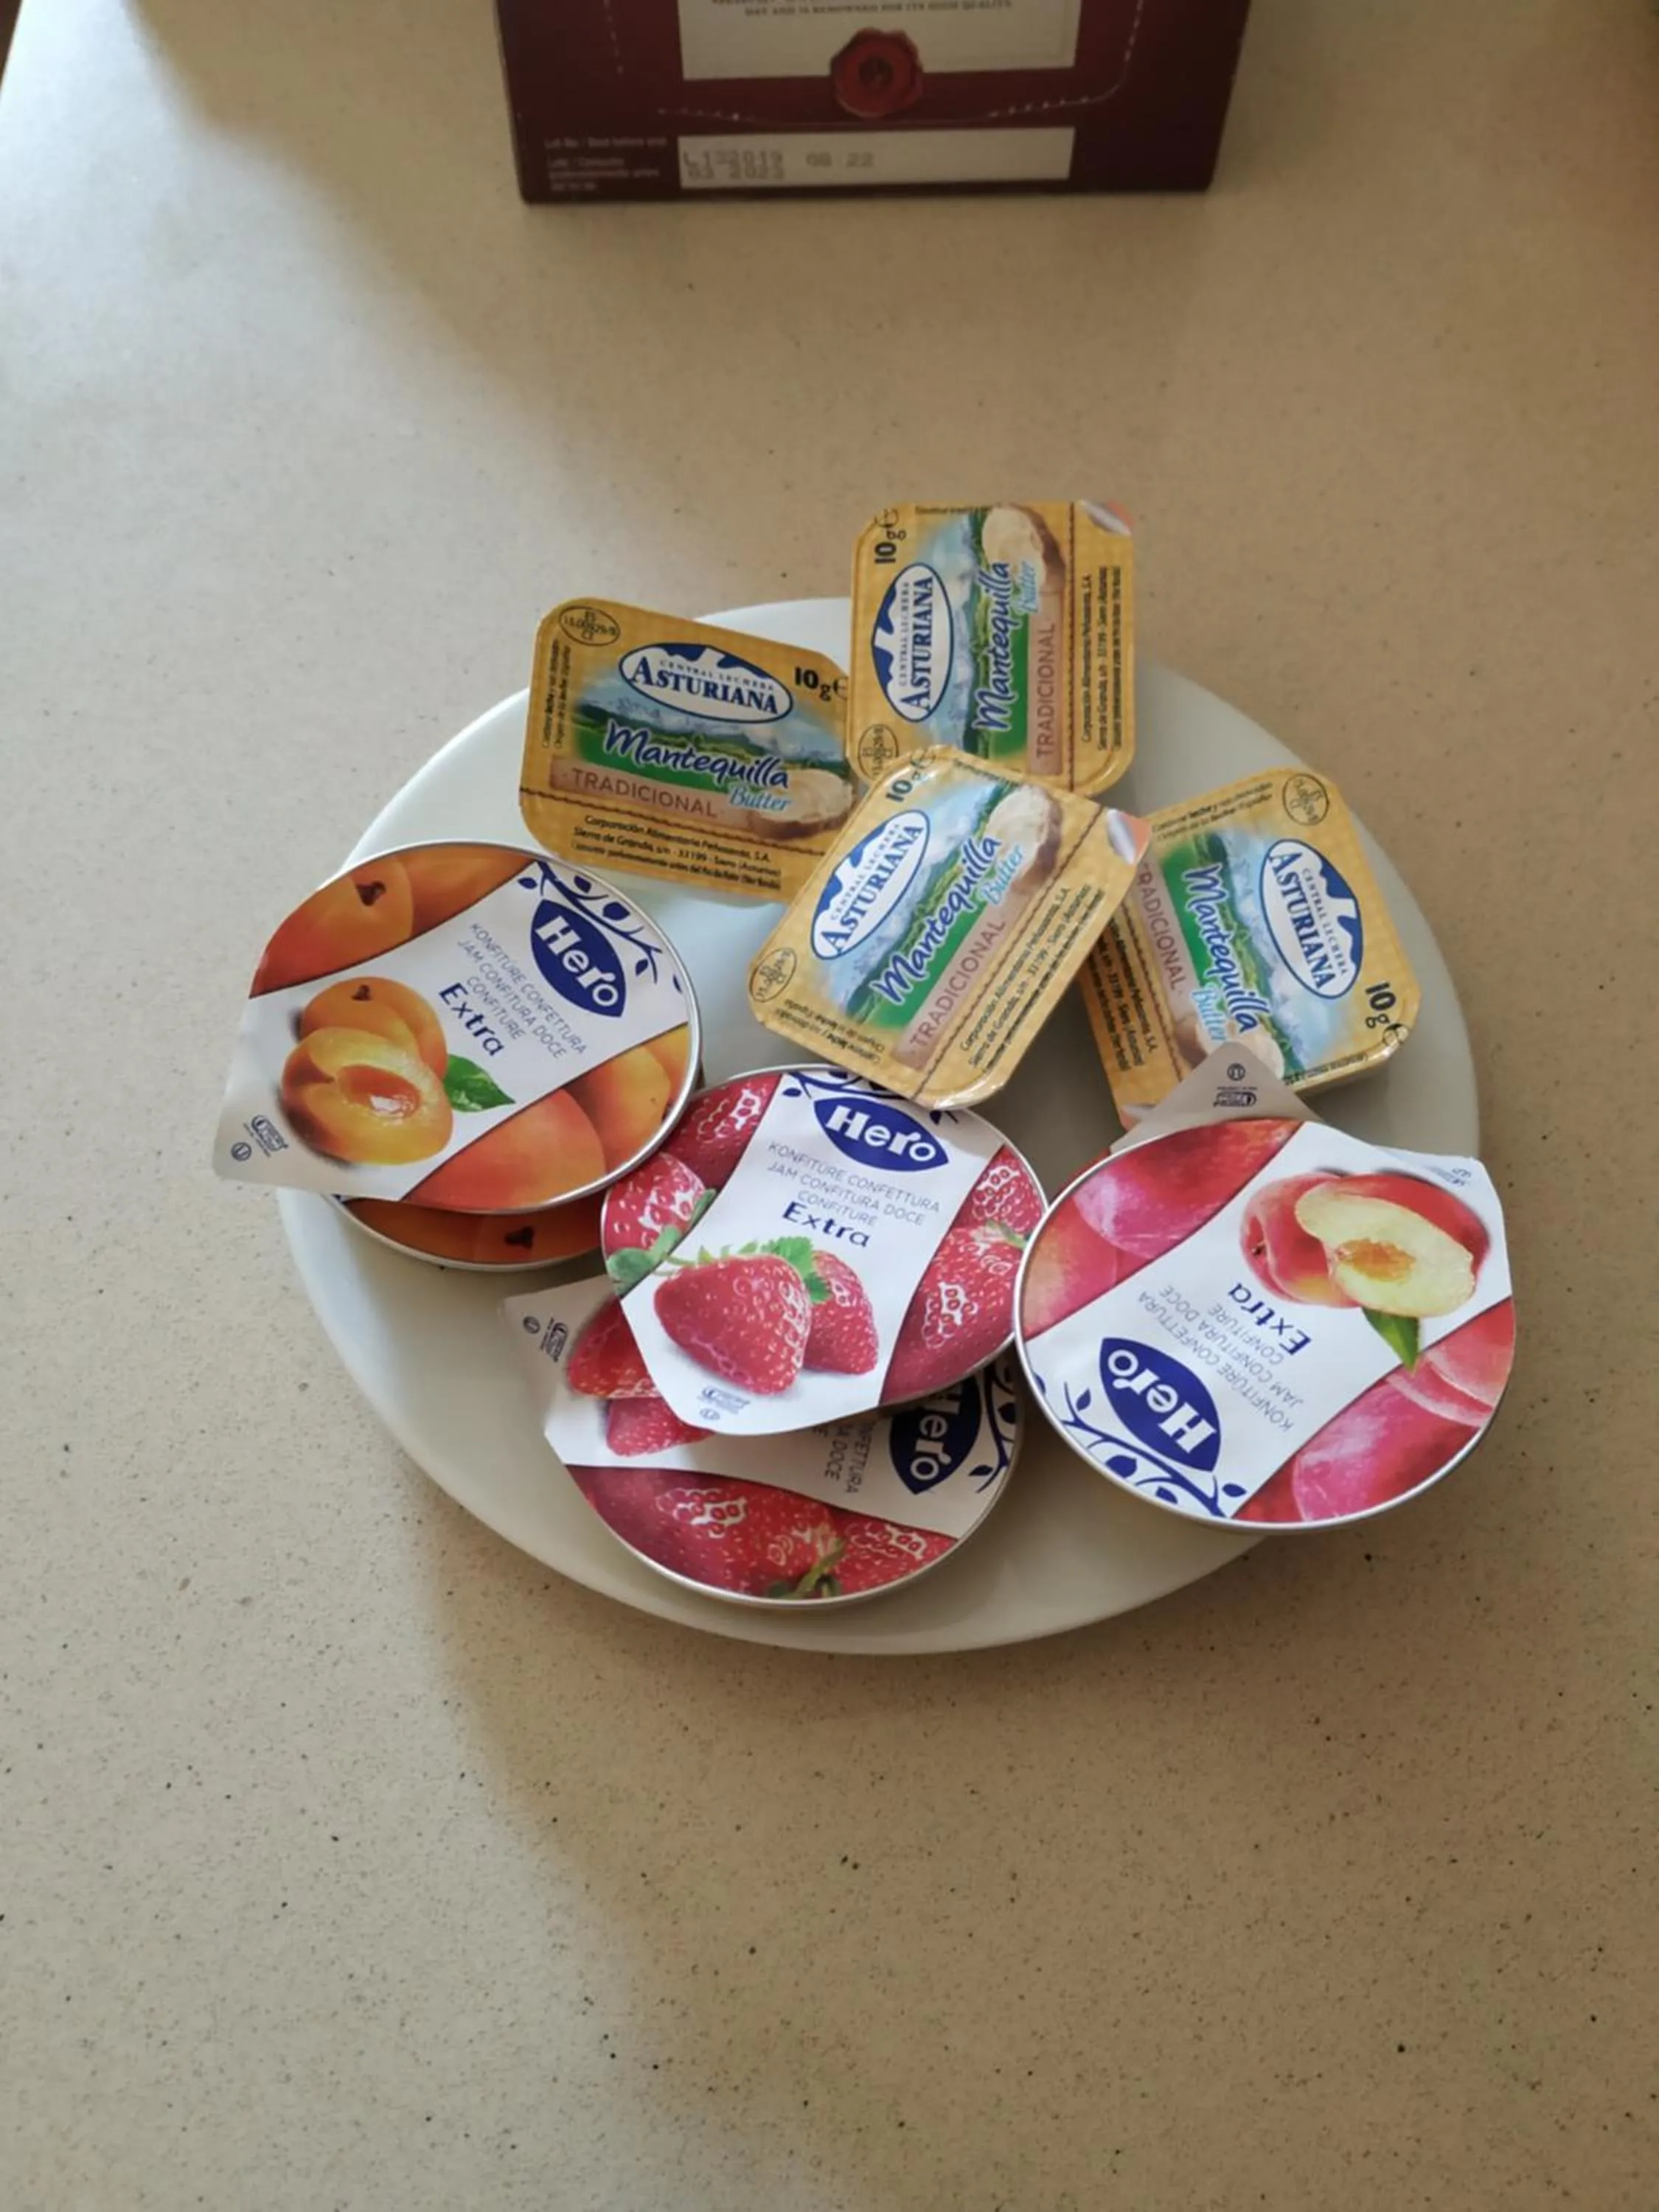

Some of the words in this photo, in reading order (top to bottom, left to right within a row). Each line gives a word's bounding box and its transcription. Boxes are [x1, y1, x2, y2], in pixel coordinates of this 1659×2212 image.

[900, 581, 910, 633] LECHERA
[1017, 561, 1039, 613] Butter
[658, 658, 713, 678] CENTRAL
[898, 637, 908, 686] CENTRAL
[900, 575, 935, 712] ASTURIANA
[973, 561, 1020, 728] Mantequilla
[630, 656, 779, 715] ASTURIANA
[1034, 623, 1057, 757] TRADICIONAL
[605, 719, 789, 789] Mantequilla
[572, 768, 717, 818] TRADICIONAL
[728, 782, 793, 812] Butter
[819, 825, 923, 953] ASTURIANA
[828, 870, 866, 922] CENTRAL
[983, 845, 1026, 905] Butter
[873, 834, 1001, 1004] Mantequilla
[1184, 864, 1269, 1033] Mantequilla
[1269, 849, 1336, 989] ASTURIANA
[1300, 866, 1329, 920] CENTRAL
[1321, 920, 1350, 976] LECHERA
[535, 917, 620, 1008] Hero
[910, 920, 1005, 1048] TRADICIONAL
[439, 982, 506, 1057] Extra
[456, 936, 484, 965] JAM
[476, 959, 539, 1027] CONFITURA
[532, 1023, 567, 1060] DOCE
[464, 974, 526, 1041] CONFITURE
[518, 980, 589, 1056] CONFETTURA
[1193, 984, 1227, 1041] Butter
[826, 1105, 936, 1163] Hero
[766, 1160, 799, 1180] JAM
[798, 1173, 881, 1211] CONFITURA
[883, 1203, 925, 1226] DOCE
[782, 1200, 871, 1248] Extra
[795, 1189, 879, 1228] CONFITURE
[846, 1172, 942, 1214] CONFETTURA
[1133, 1289, 1222, 1370] CONFETTURA
[1158, 1283, 1202, 1324] DOCE
[1206, 1298, 1285, 1370] CONFITURE
[1229, 1282, 1312, 1356] Extra
[1194, 1315, 1274, 1388] CONFITURA
[1107, 1349, 1217, 1455] Hero
[1267, 1377, 1304, 1412] JAM
[824, 1439, 849, 1482] DOCE
